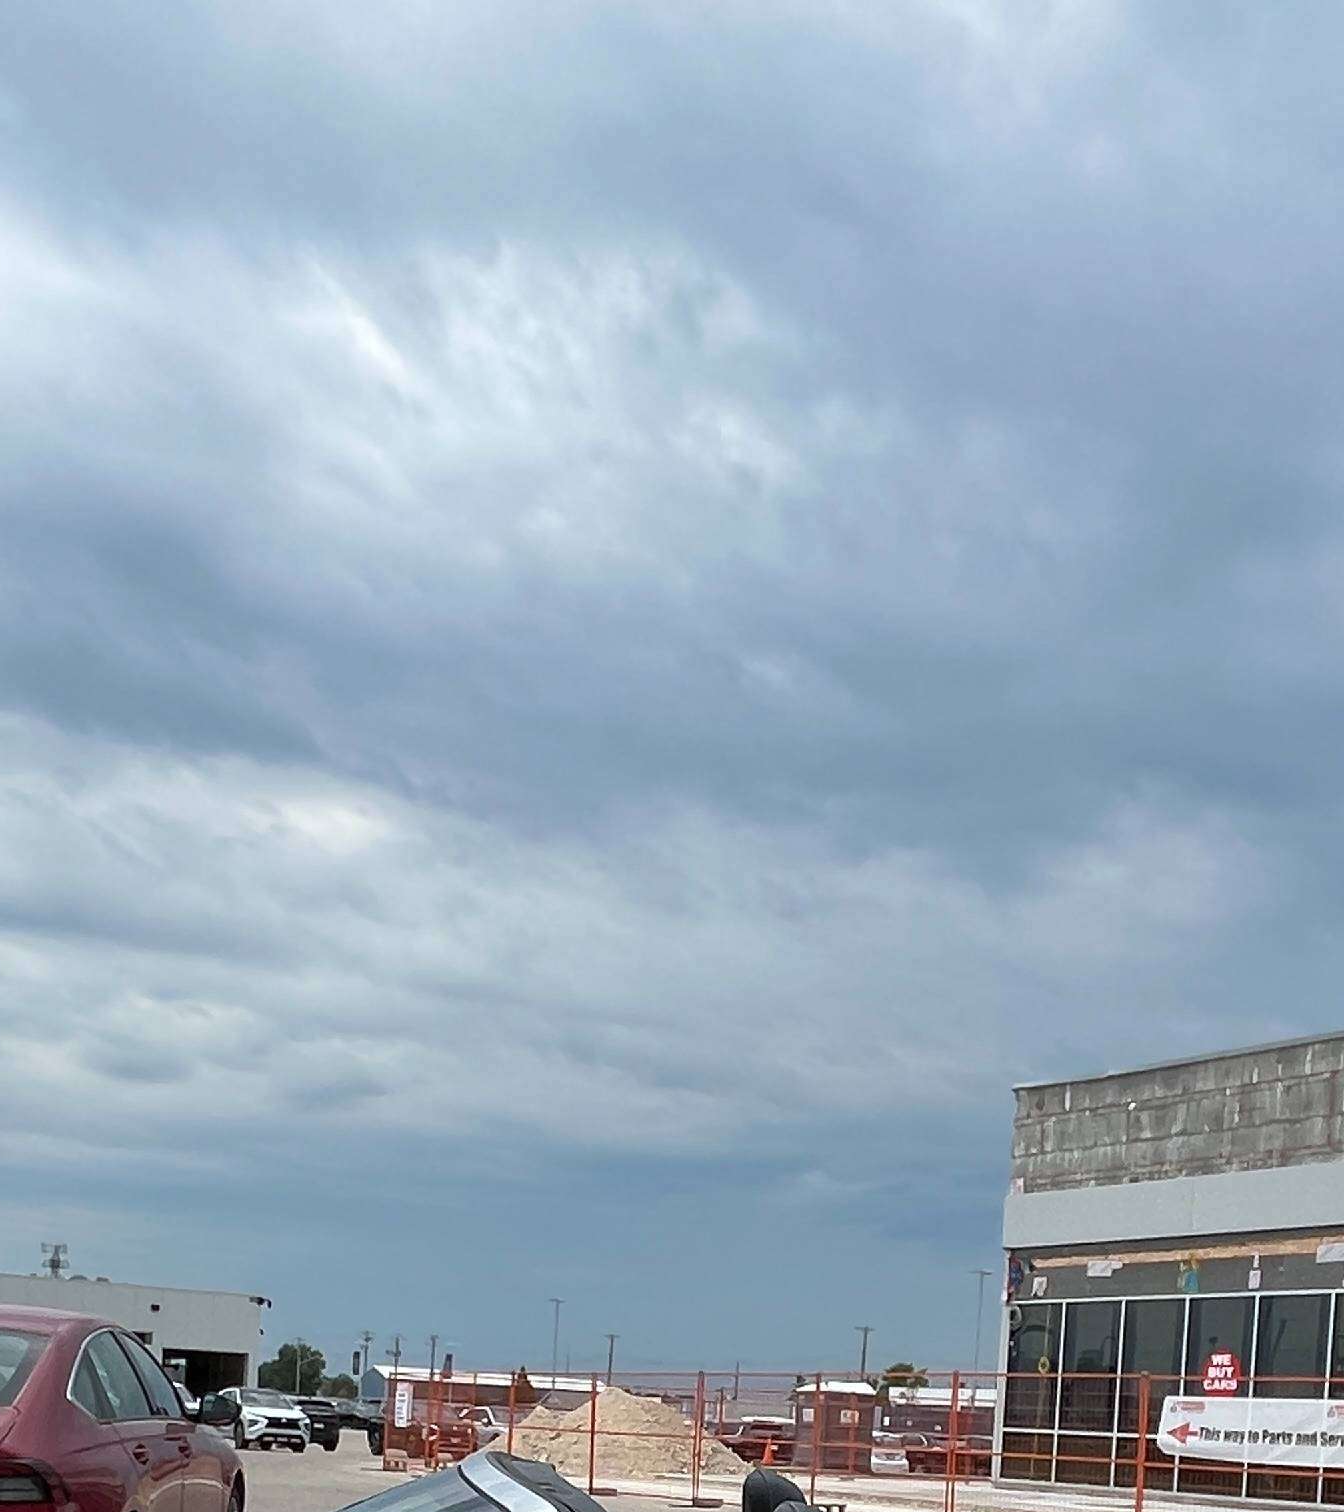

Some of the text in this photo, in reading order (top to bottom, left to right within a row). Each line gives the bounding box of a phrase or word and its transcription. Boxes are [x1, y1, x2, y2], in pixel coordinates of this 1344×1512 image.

[1211, 1354, 1232, 1366] WE
[1207, 1367, 1235, 1379] BUY
[1203, 1379, 1238, 1391] CARS
[1199, 1427, 1221, 1442] This
[1224, 1430, 1245, 1446] way
[1247, 1429, 1259, 1443] to
[1262, 1430, 1293, 1446] Parts
[1295, 1432, 1317, 1446] and
